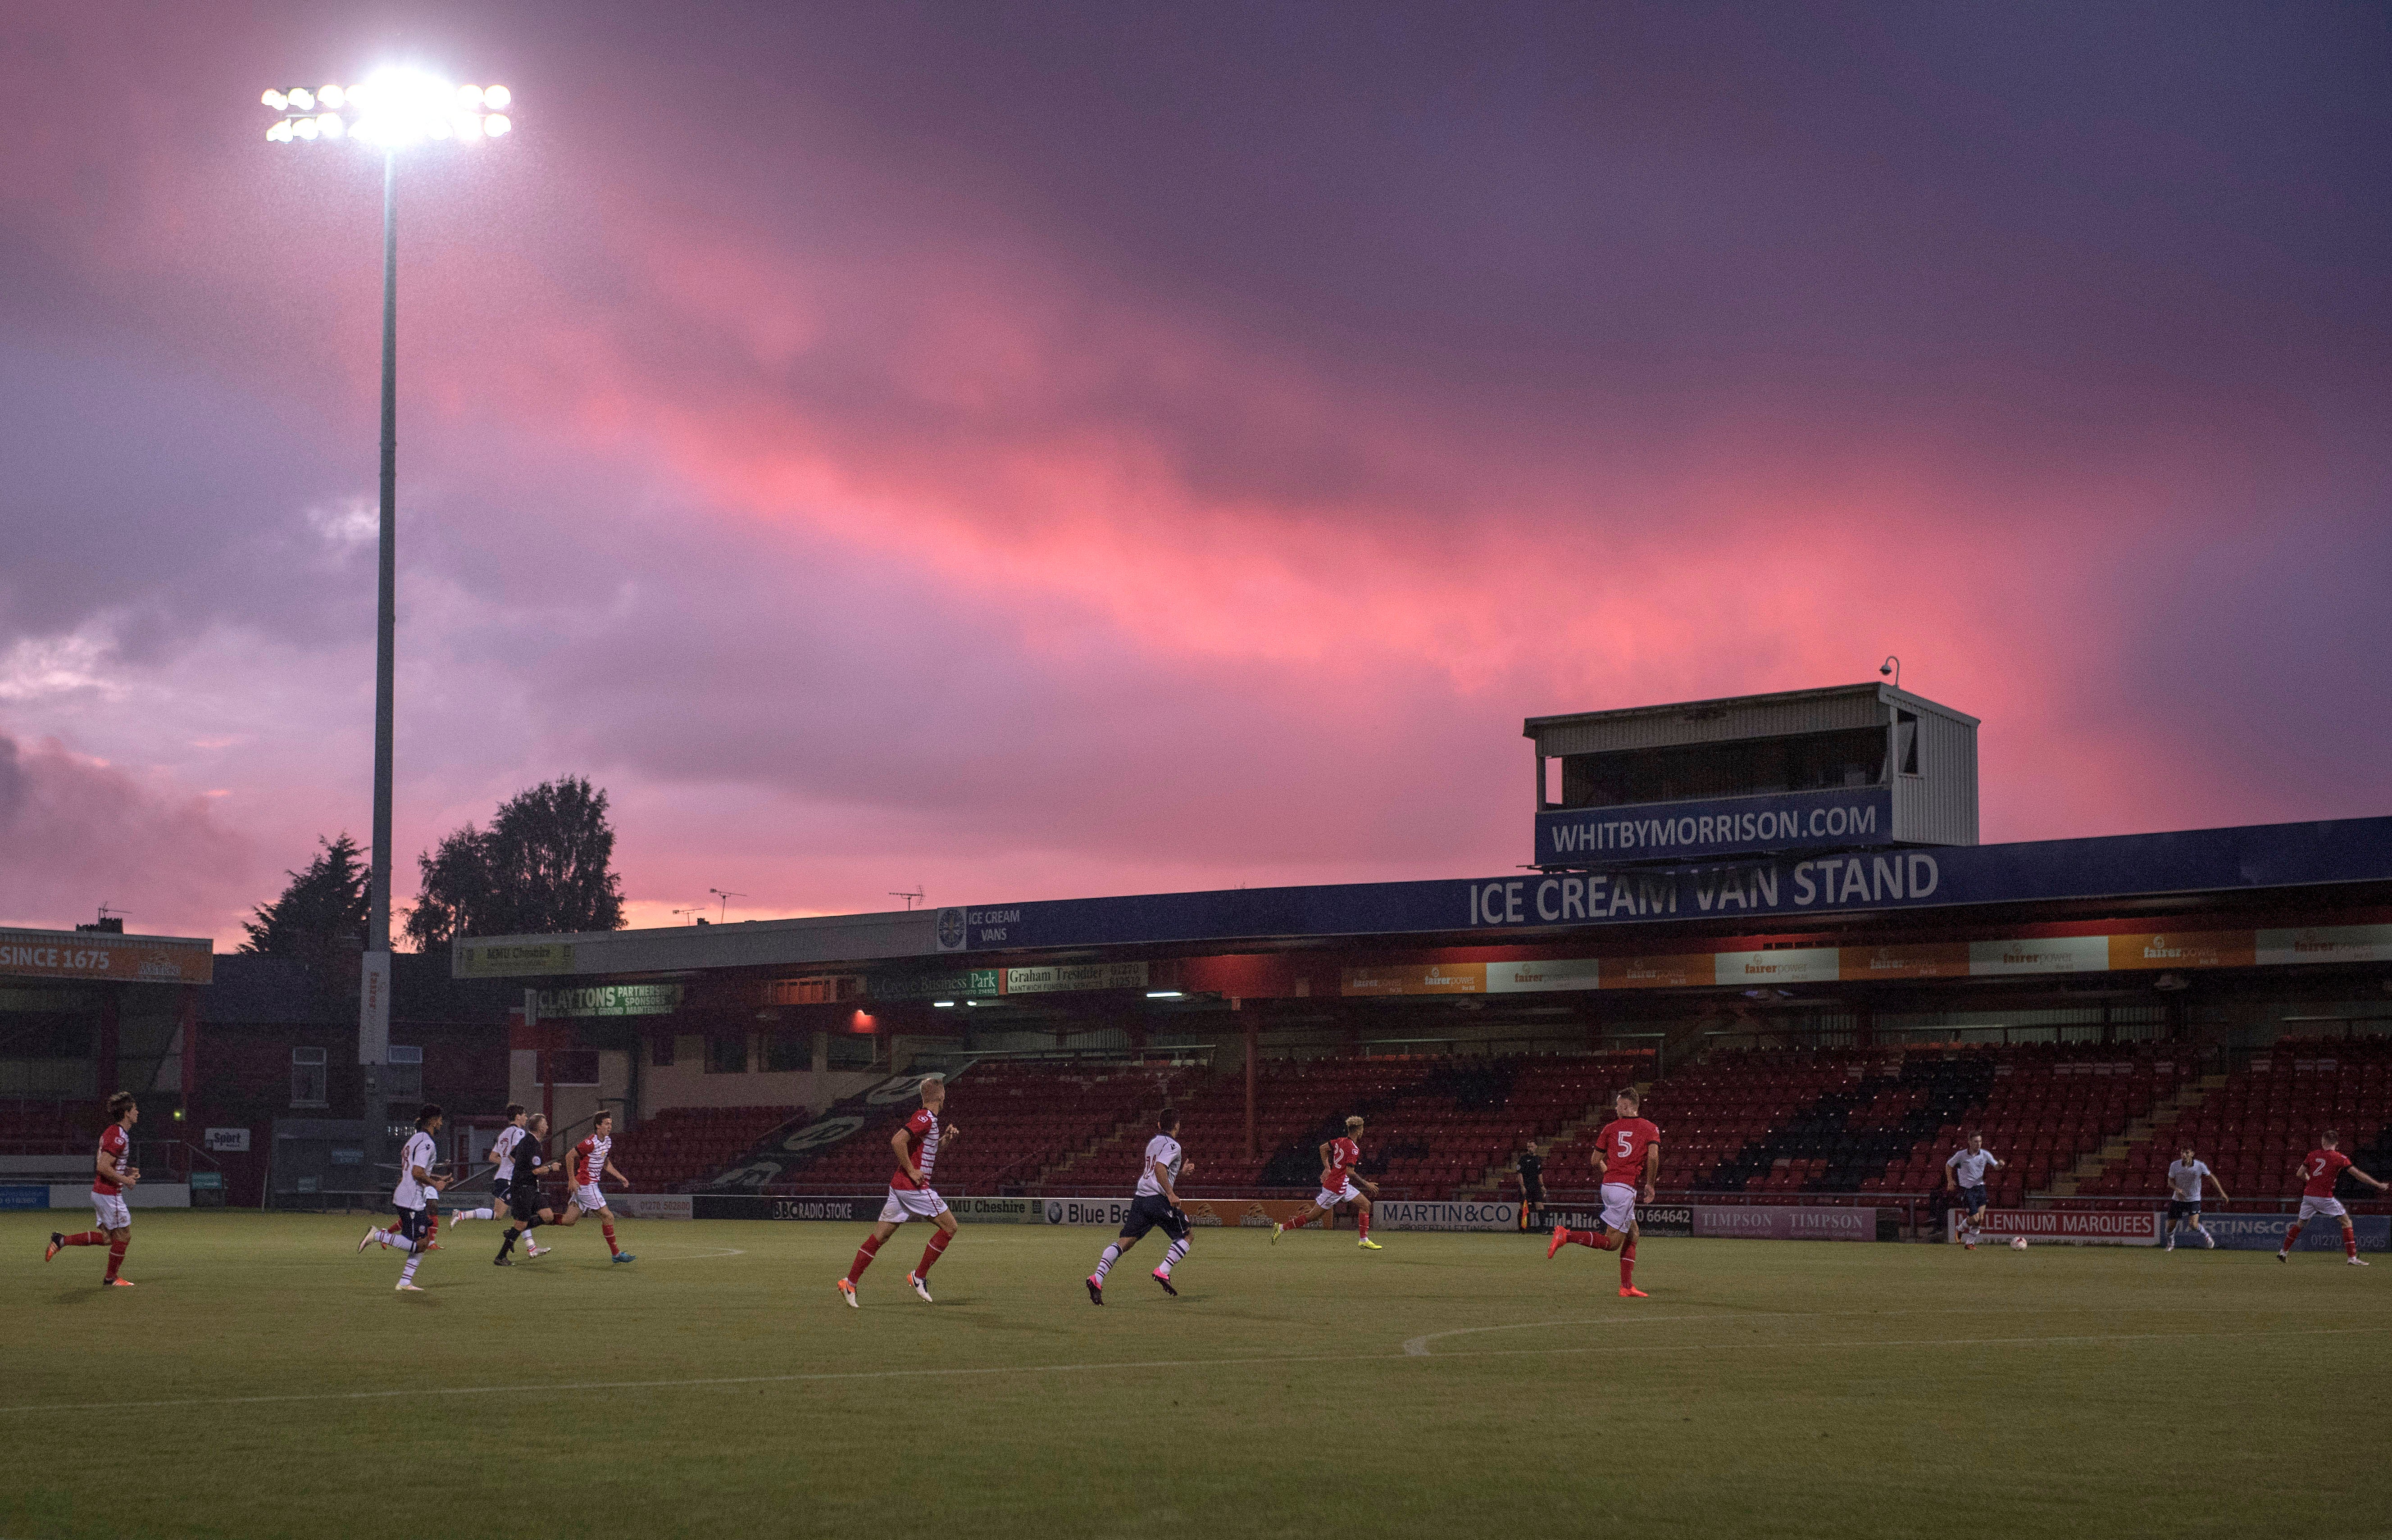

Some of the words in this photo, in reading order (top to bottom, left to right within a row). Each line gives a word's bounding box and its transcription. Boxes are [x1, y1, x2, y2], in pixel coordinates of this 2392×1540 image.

[1553, 804, 1875, 852] WHITBYMORRISON.COM
[1470, 881, 1524, 925] ICE
[1536, 872, 1677, 922] CREAM
[1696, 865, 1778, 912] VAN
[1794, 854, 1938, 906] STAND
[968, 912, 982, 925] ICE
[985, 909, 1020, 924] CREAM
[981, 927, 1007, 941] VANS
[0, 946, 58, 968] SINCE
[63, 950, 109, 970] 1675
[2003, 952, 2073, 964] fairerpower
[2143, 946, 2218, 959] fairerpower
[1009, 968, 1050, 983] Graham
[1054, 967, 1103, 980] Tresidder
[1111, 964, 1139, 976] 01270
[1745, 963, 1807, 975] fairerpower
[921, 976, 967, 991] Business
[970, 972, 996, 988] Park
[1424, 975, 1475, 986] fairerpower
[1010, 984, 1041, 992] NANTWICH
[538, 987, 616, 1008] CLAYTONS
[618, 985, 673, 997] PARTNERSHIP
[625, 996, 666, 1006] SPONSORS
[598, 1007, 623, 1016] GROUND
[627, 1005, 673, 1014] MAINTENANCE
[214, 1132, 241, 1146] Sport
[1617, 1131, 1633, 1158] 5
[2312, 1157, 2327, 1177] 2
[640, 1201, 661, 1214] 01270
[773, 1202, 798, 1219] BBC
[799, 1203, 824, 1219] RADIO
[825, 1203, 852, 1219] STOKE
[975, 1200, 1025, 1213] Cheshire
[1383, 1204, 1512, 1222] MARTIN&CO
[1069, 1204, 1105, 1223] Blue
[1110, 1204, 1130, 1224] Be
[1646, 1209, 1691, 1223] 664642
[1701, 1213, 1772, 1227] TIMPSON
[1789, 1214, 1863, 1228] TIMPSON
[1958, 1213, 2057, 1231] MLENNIUM
[2063, 1215, 2151, 1234] MARQUEES
[2310, 1235, 2342, 1246] 01270
[2352, 1236, 2386, 1248] 00905
